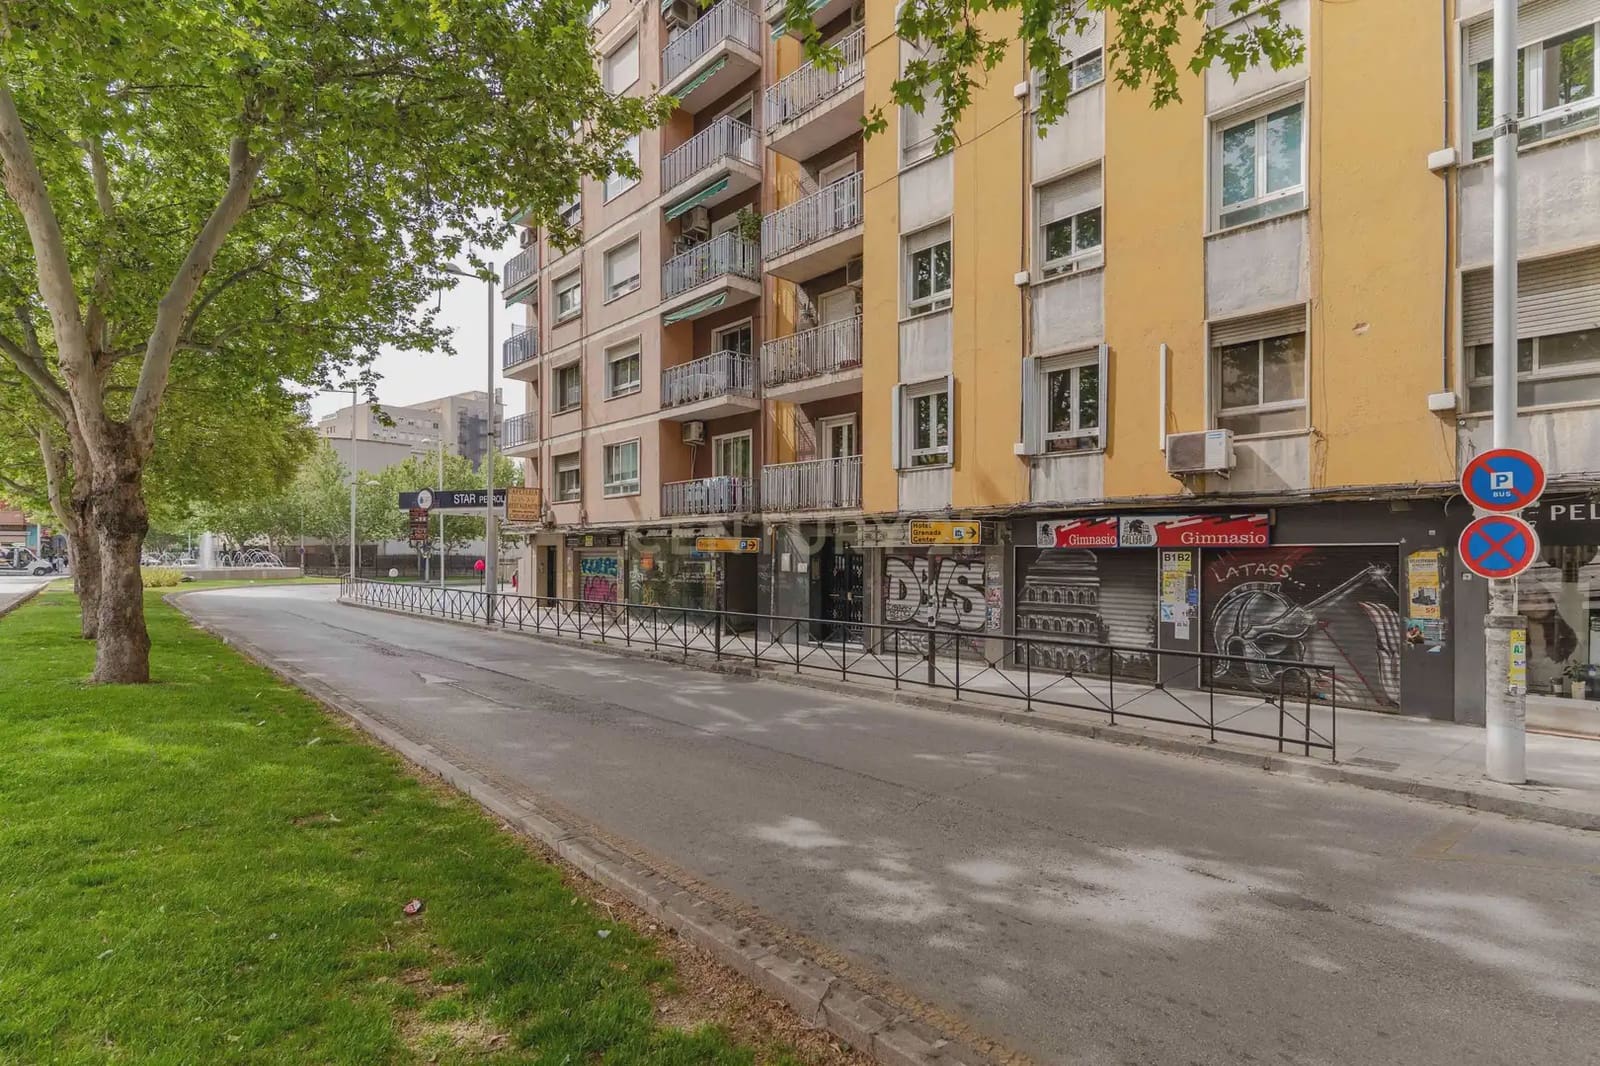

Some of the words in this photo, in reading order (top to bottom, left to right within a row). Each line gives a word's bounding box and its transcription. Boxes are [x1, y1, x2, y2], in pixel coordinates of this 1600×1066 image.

[1496, 475, 1509, 487] P
[453, 493, 476, 504] STAR
[479, 495, 505, 504] PEROL
[1492, 490, 1511, 498] BUS
[1069, 534, 1117, 546] Gimnasio
[1181, 532, 1266, 544] Gimnasio
[1164, 554, 1176, 562] B1
[1178, 554, 1190, 562] B2
